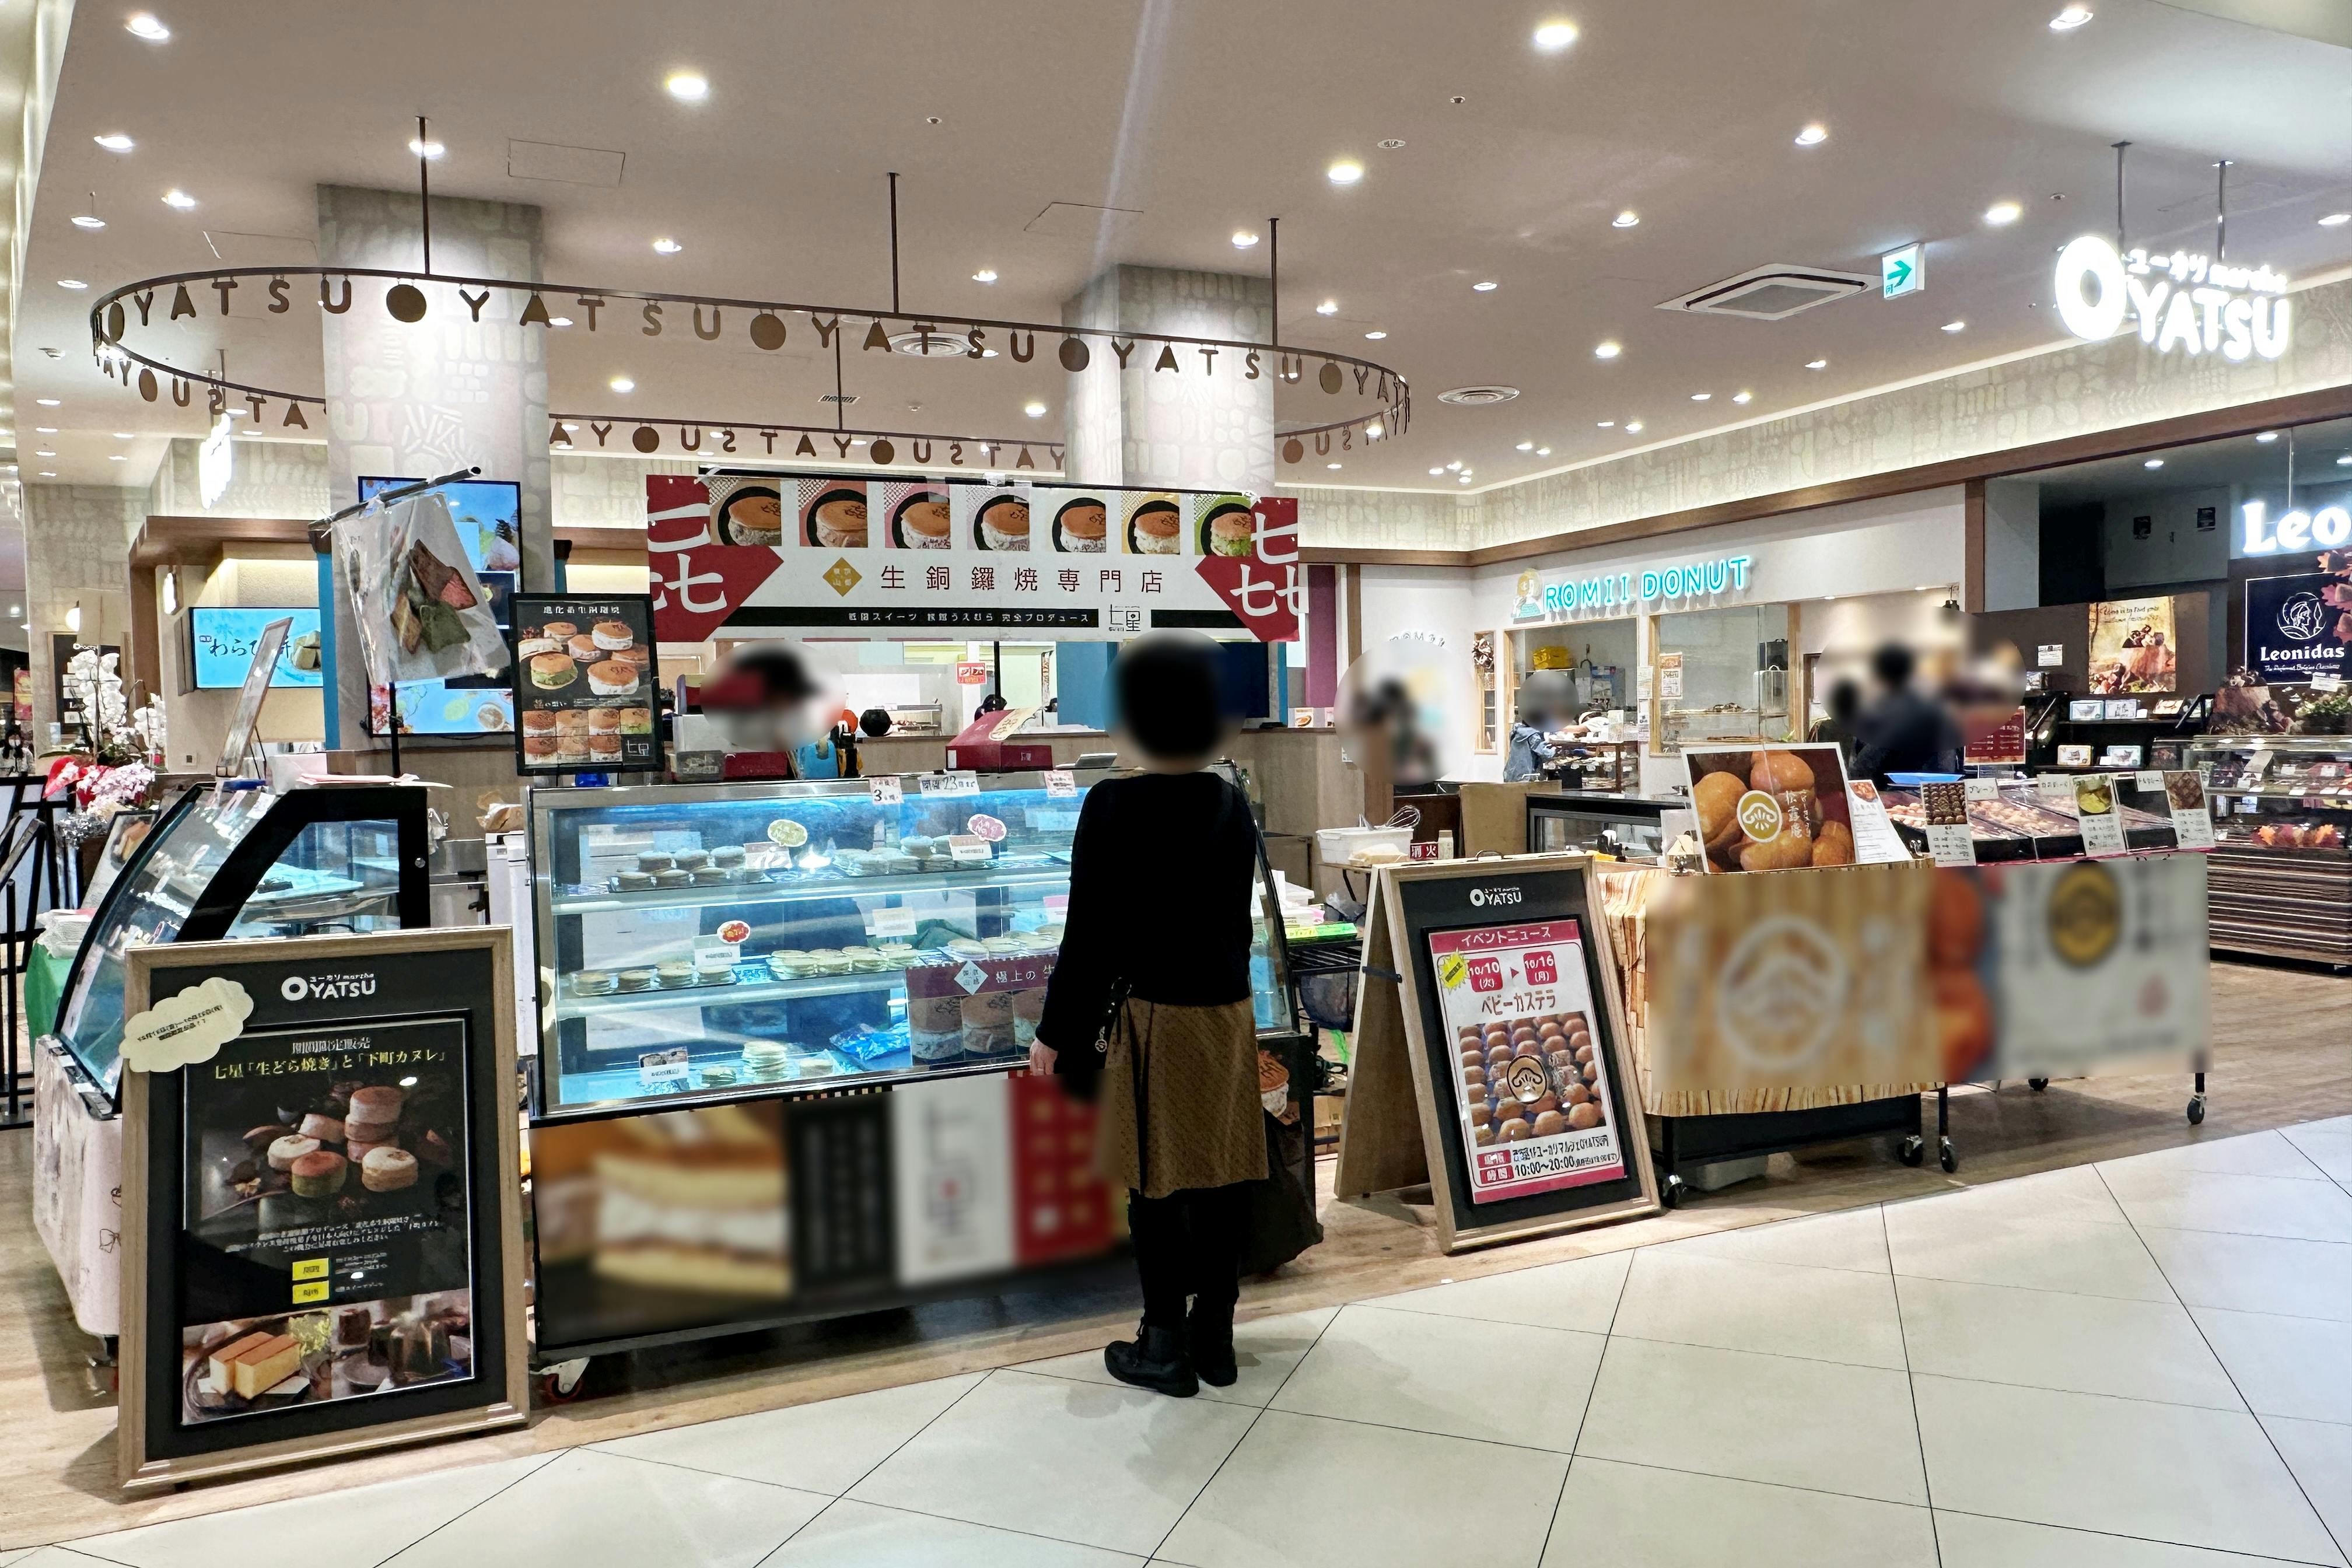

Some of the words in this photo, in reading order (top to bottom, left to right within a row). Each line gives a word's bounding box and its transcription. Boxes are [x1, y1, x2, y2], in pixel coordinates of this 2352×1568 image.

[2055, 236, 2290, 361] OYATSU
[2243, 501, 2352, 554] Leo
[880, 564, 1163, 594] 生銅鑼焼専門店
[1543, 572, 1631, 613] ROMII
[1640, 555, 1751, 601] DONUT
[2260, 643, 2345, 662] Leonidas
[1469, 888, 1522, 907] OYATSU
[1461, 926, 1551, 947] イベントニュース
[1469, 959, 1500, 976] 10/10
[1524, 955, 1555, 969] 10/16
[281, 976, 376, 1002] OYATSU
[1482, 989, 1557, 1016] ベビーカステラ
